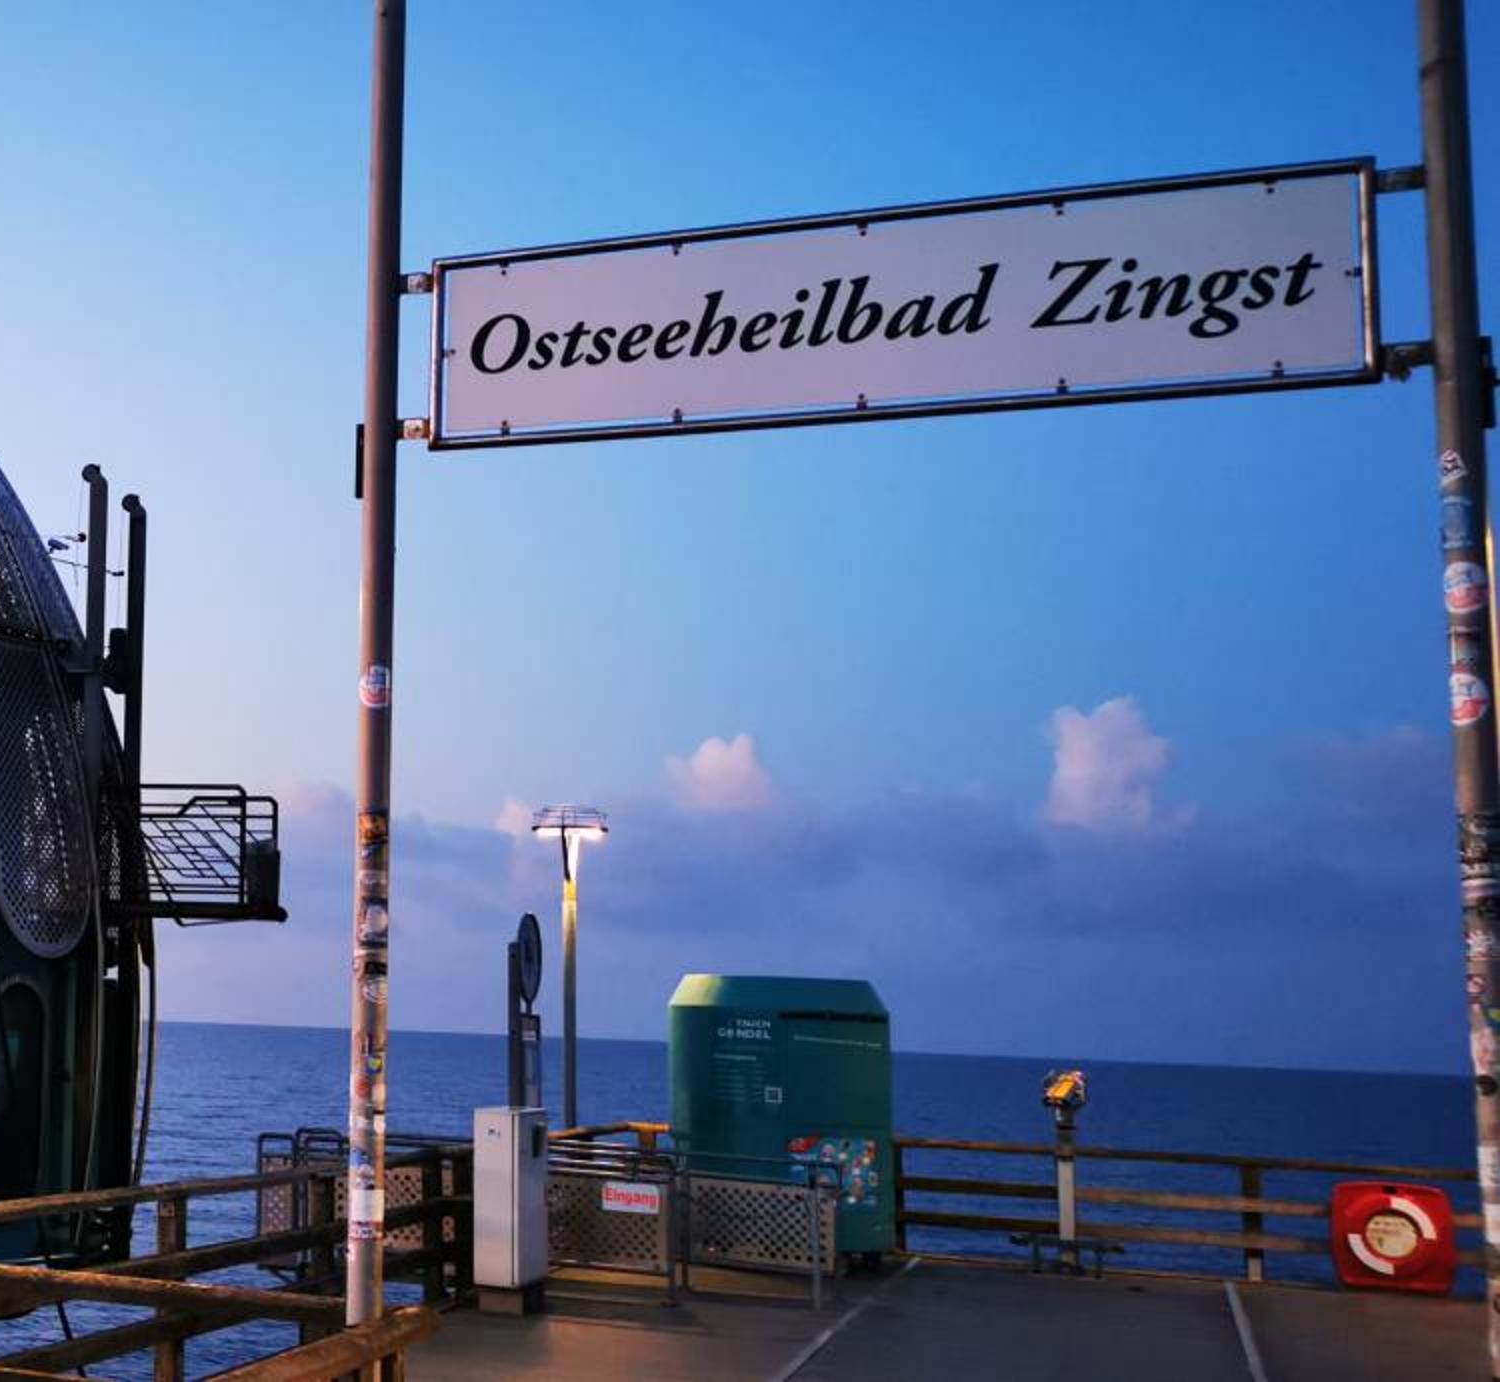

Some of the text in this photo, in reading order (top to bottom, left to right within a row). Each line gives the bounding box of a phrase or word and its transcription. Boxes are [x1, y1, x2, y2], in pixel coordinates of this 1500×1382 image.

[470, 253, 1323, 374] Ostseeheilbad Zingst
[604, 1187, 658, 1207] Eingang
